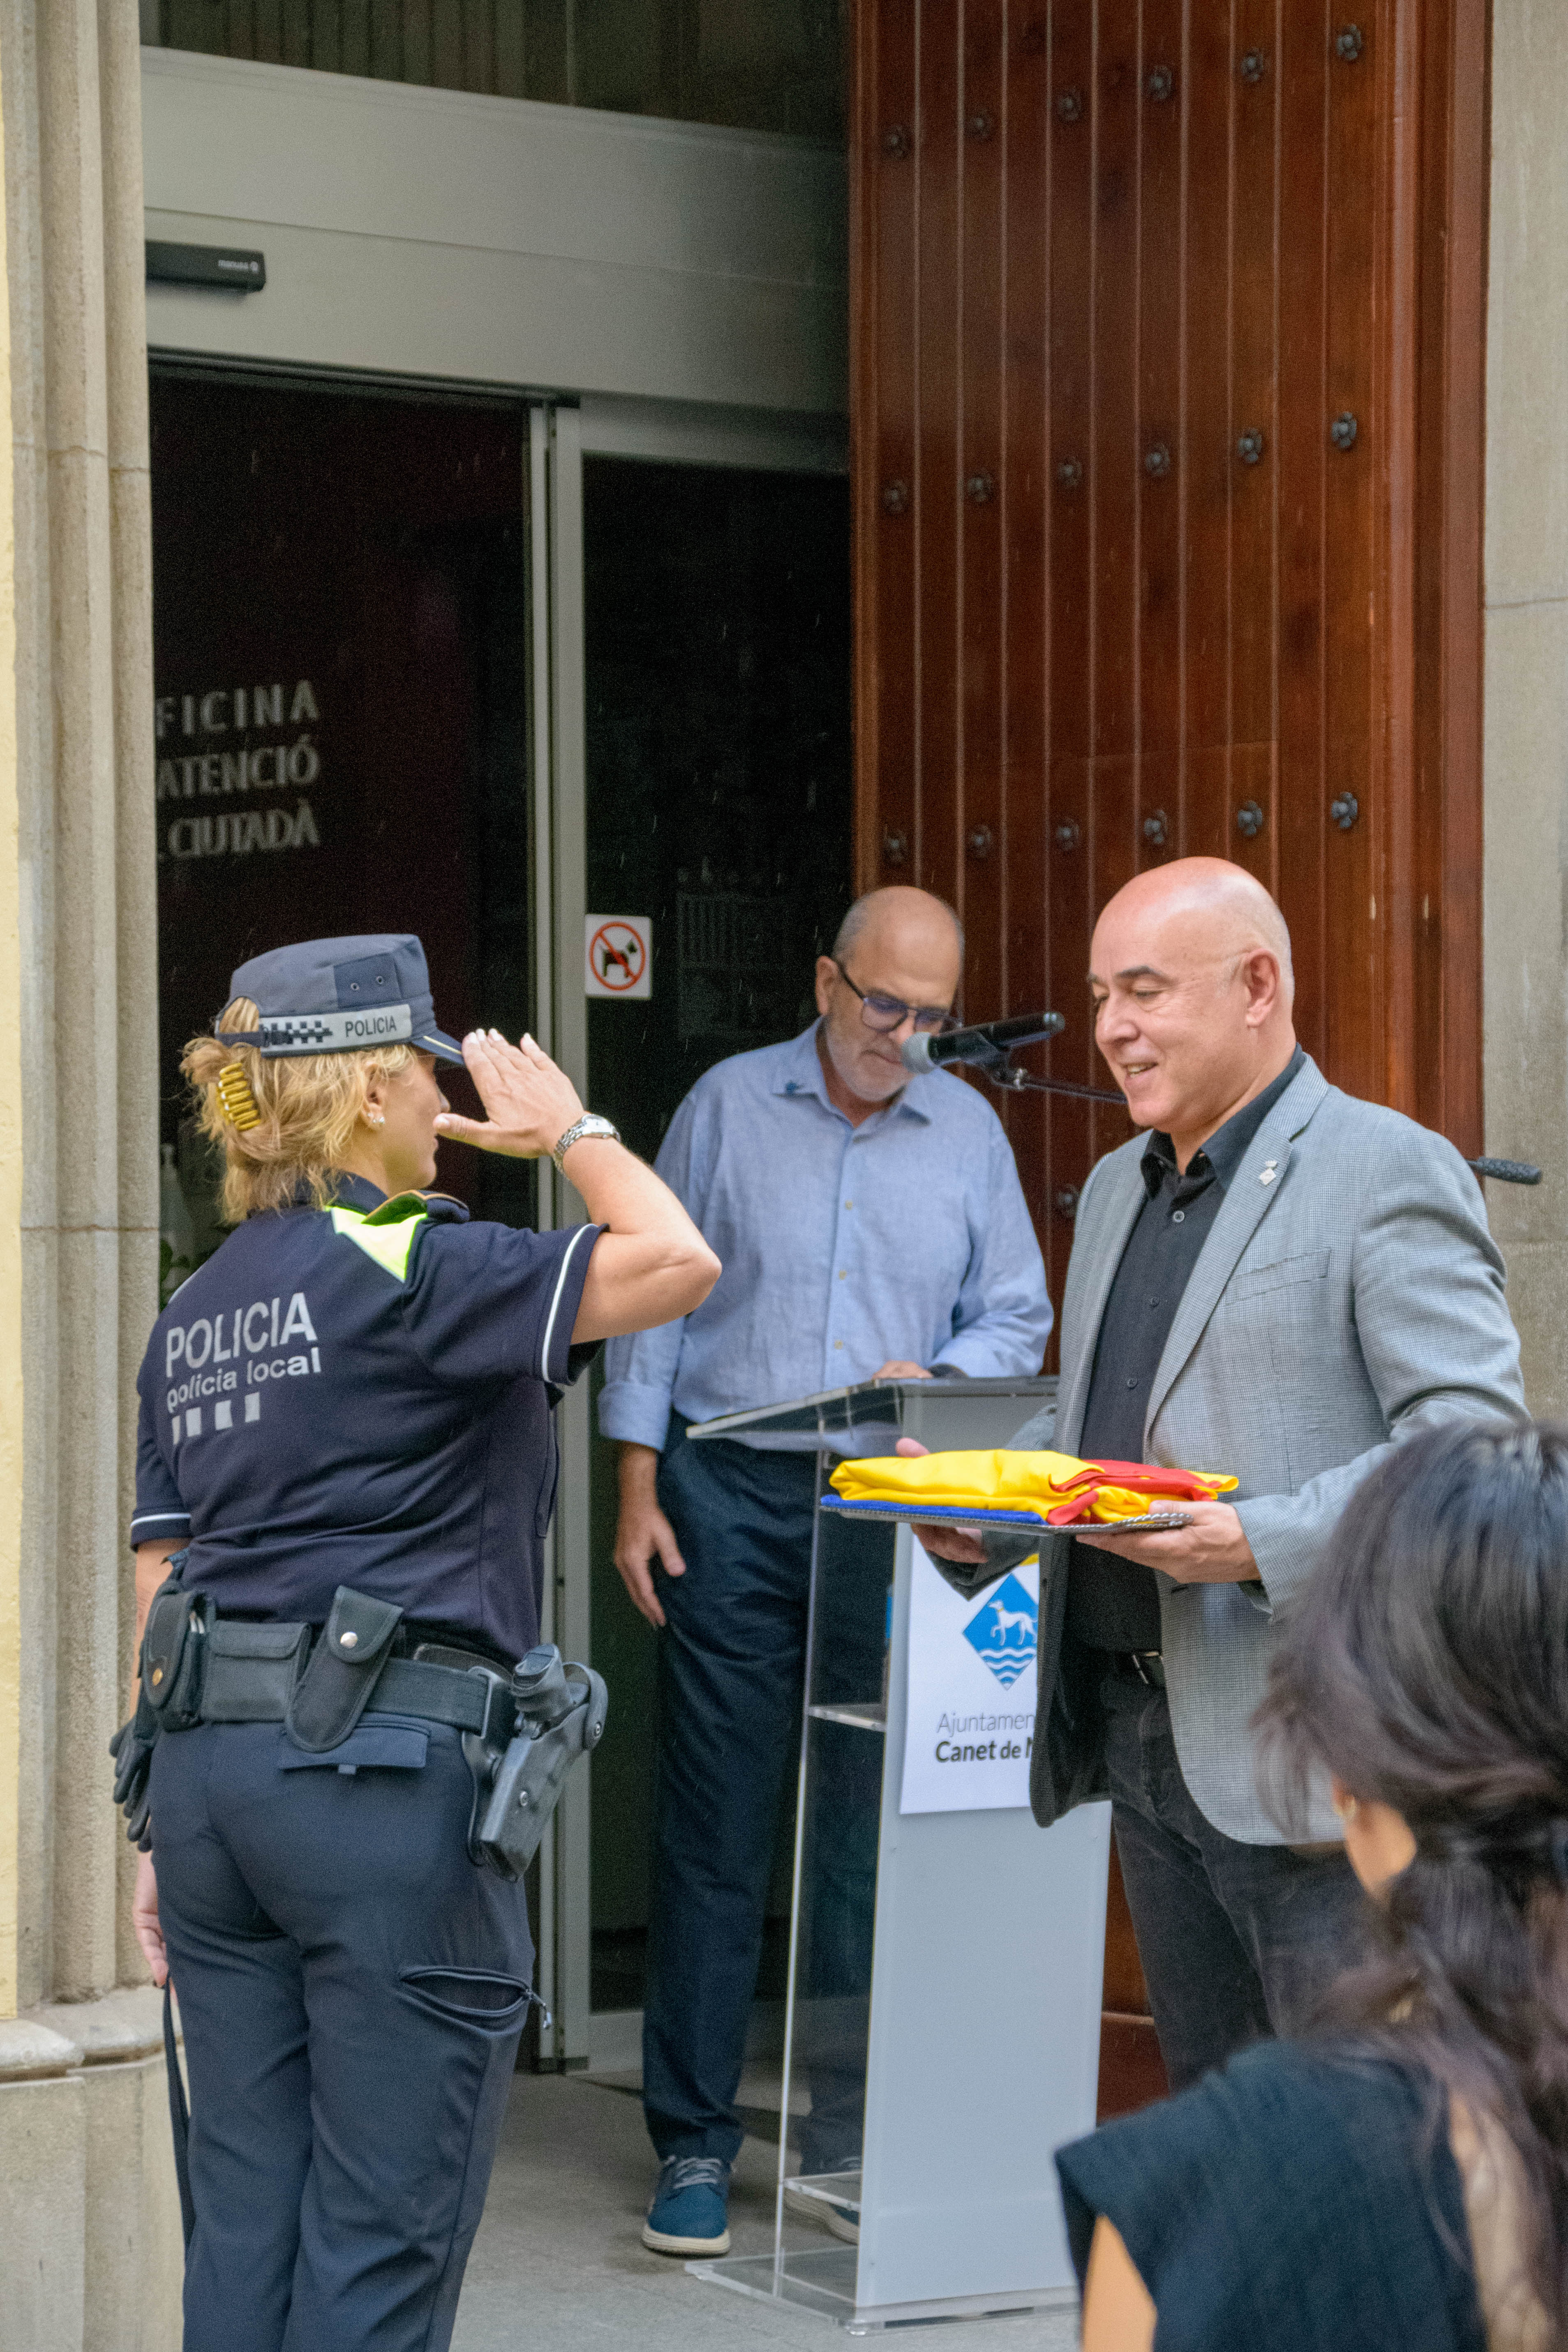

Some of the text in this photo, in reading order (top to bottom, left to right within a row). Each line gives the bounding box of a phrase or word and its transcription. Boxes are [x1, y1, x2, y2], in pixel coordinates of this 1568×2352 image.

[157, 734, 320, 800] ATENCIÓ
[168, 797, 320, 857] CIUTADÀ
[345, 1016, 397, 1038] POLICIA
[166, 1292, 318, 1378] POLICIA
[167, 1346, 321, 1414] policia local
[935, 1740, 996, 1763] Canet
[1000, 1740, 1021, 1759] de
